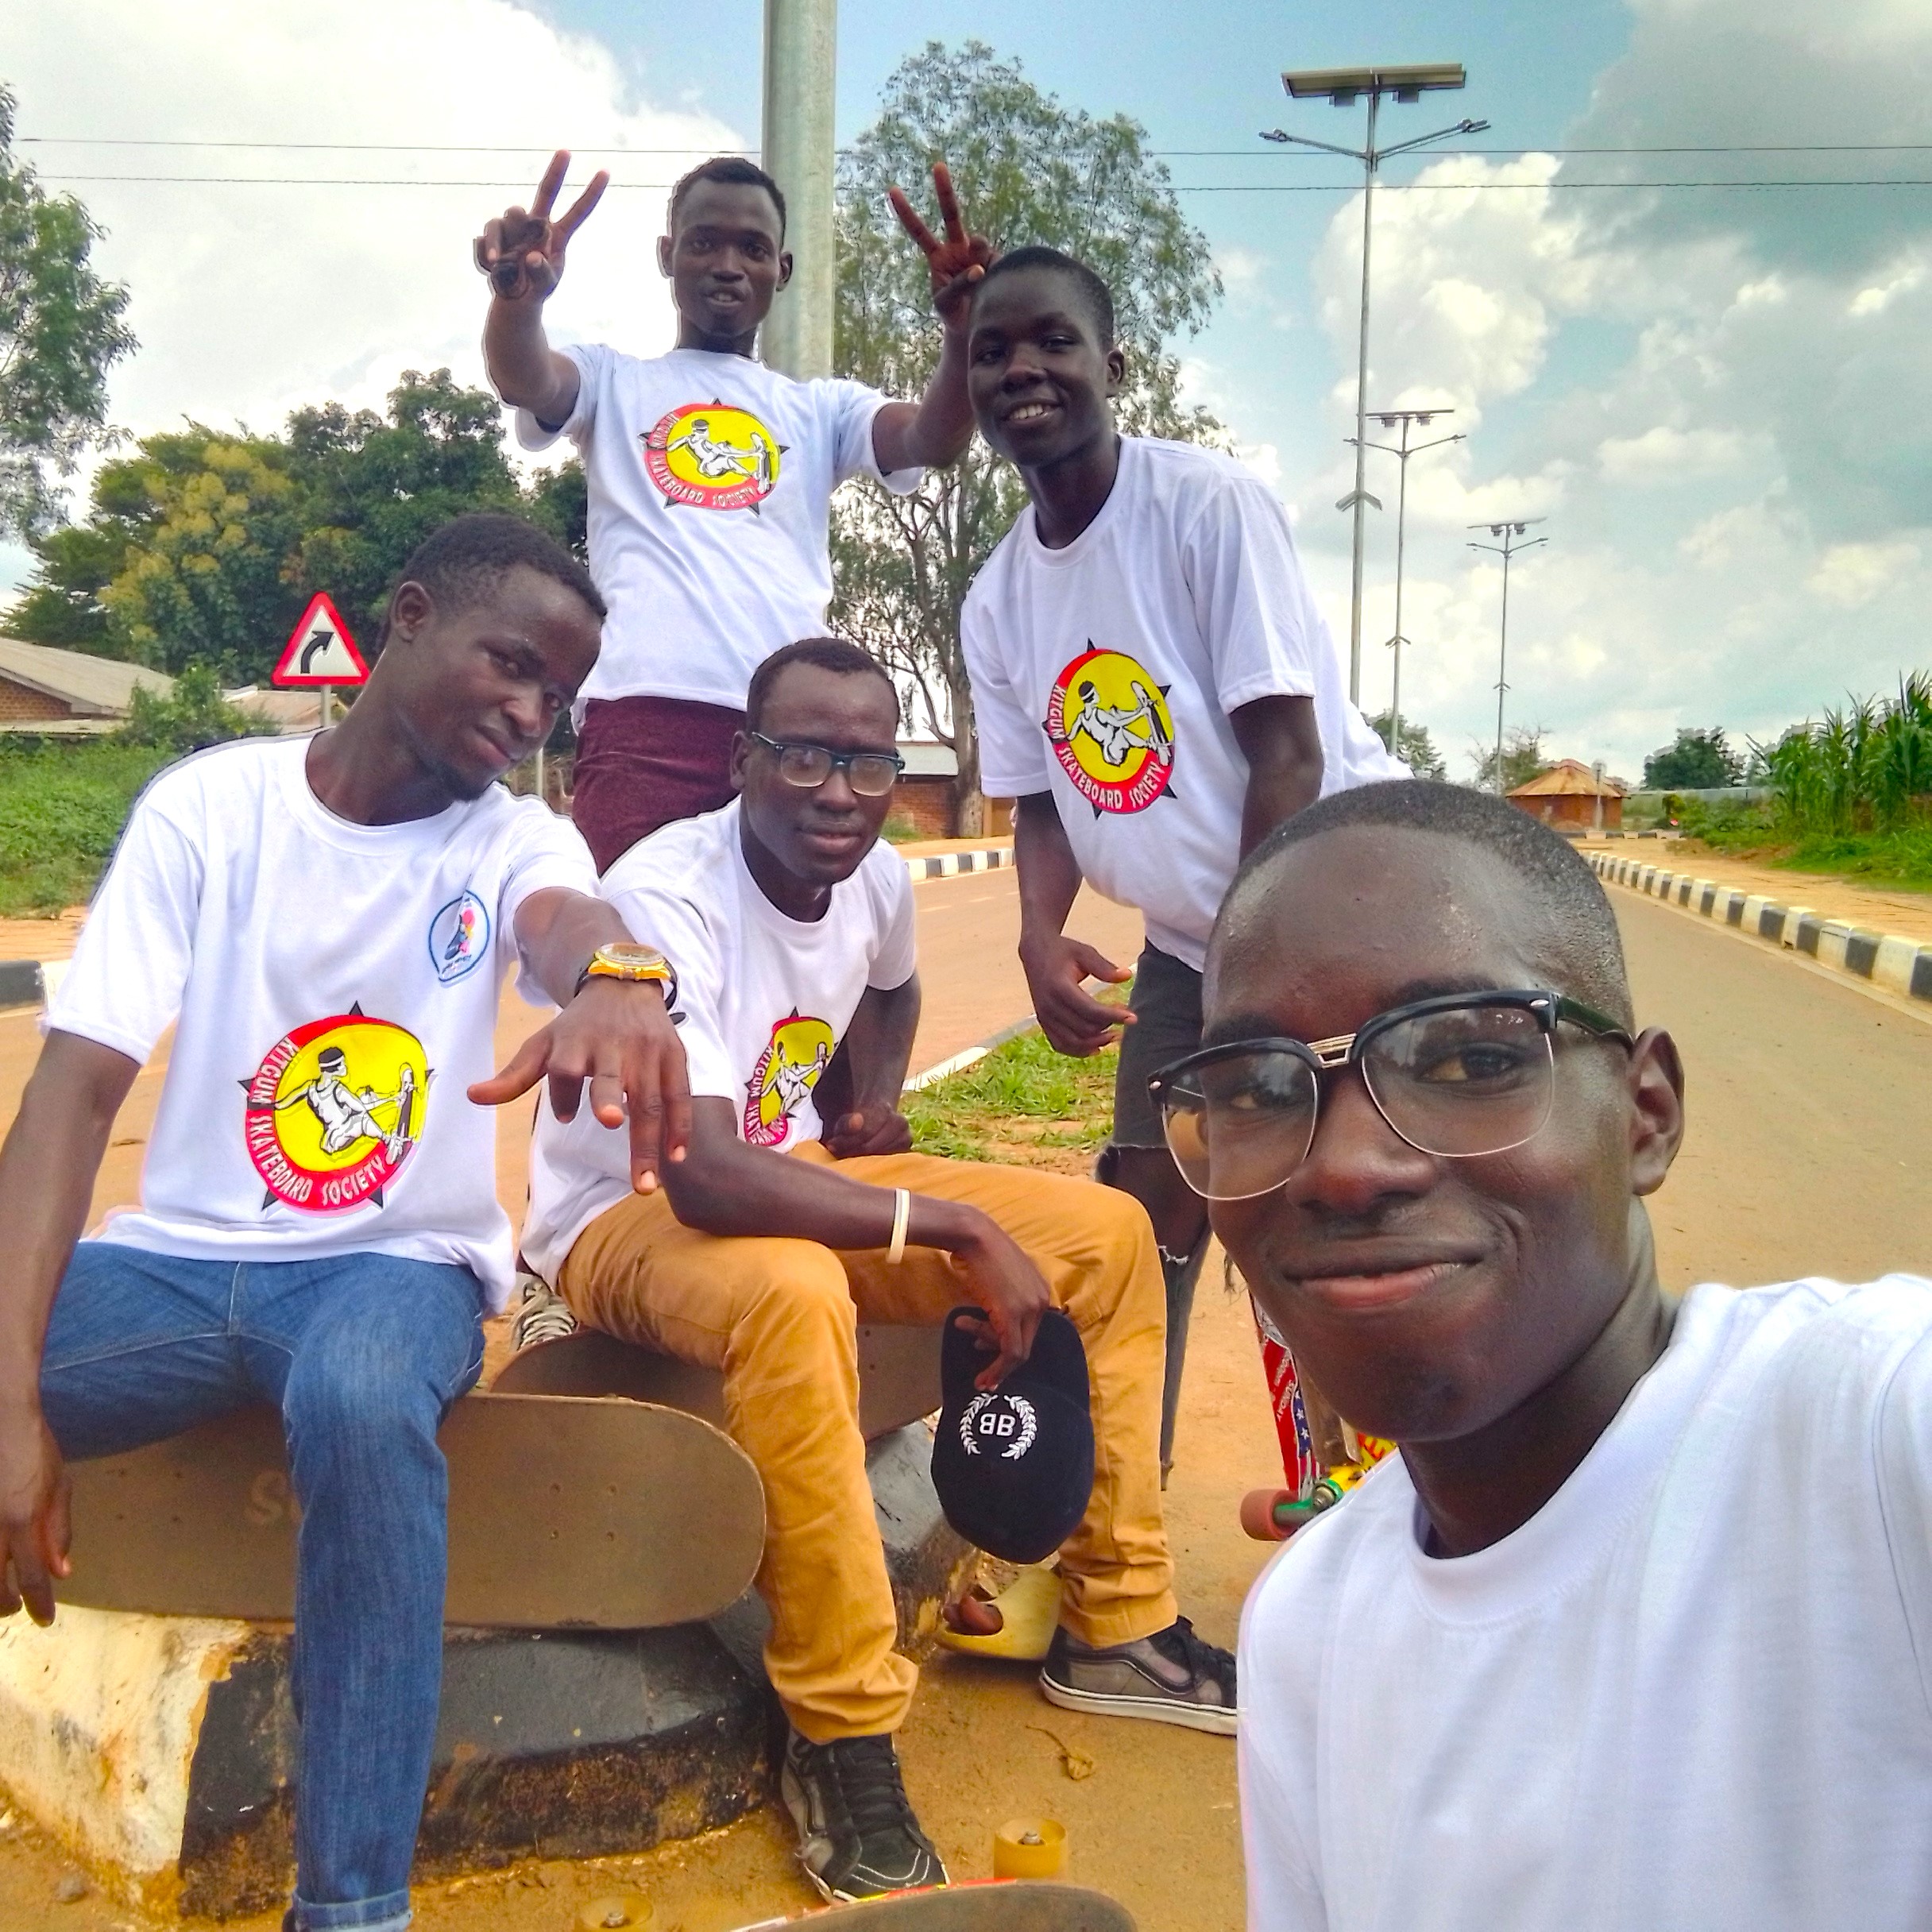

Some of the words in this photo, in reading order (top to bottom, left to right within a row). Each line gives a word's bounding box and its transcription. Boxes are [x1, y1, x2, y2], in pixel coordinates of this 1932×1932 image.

[1049, 685, 1067, 740] KITGUM
[1058, 747, 1123, 810] SKATEBOARD
[1129, 760, 1165, 808] SOCIETY
[251, 1035, 299, 1104] KITGUM
[248, 1115, 314, 1203] SKATEBOARD
[321, 1153, 386, 1206] SOCIETY
